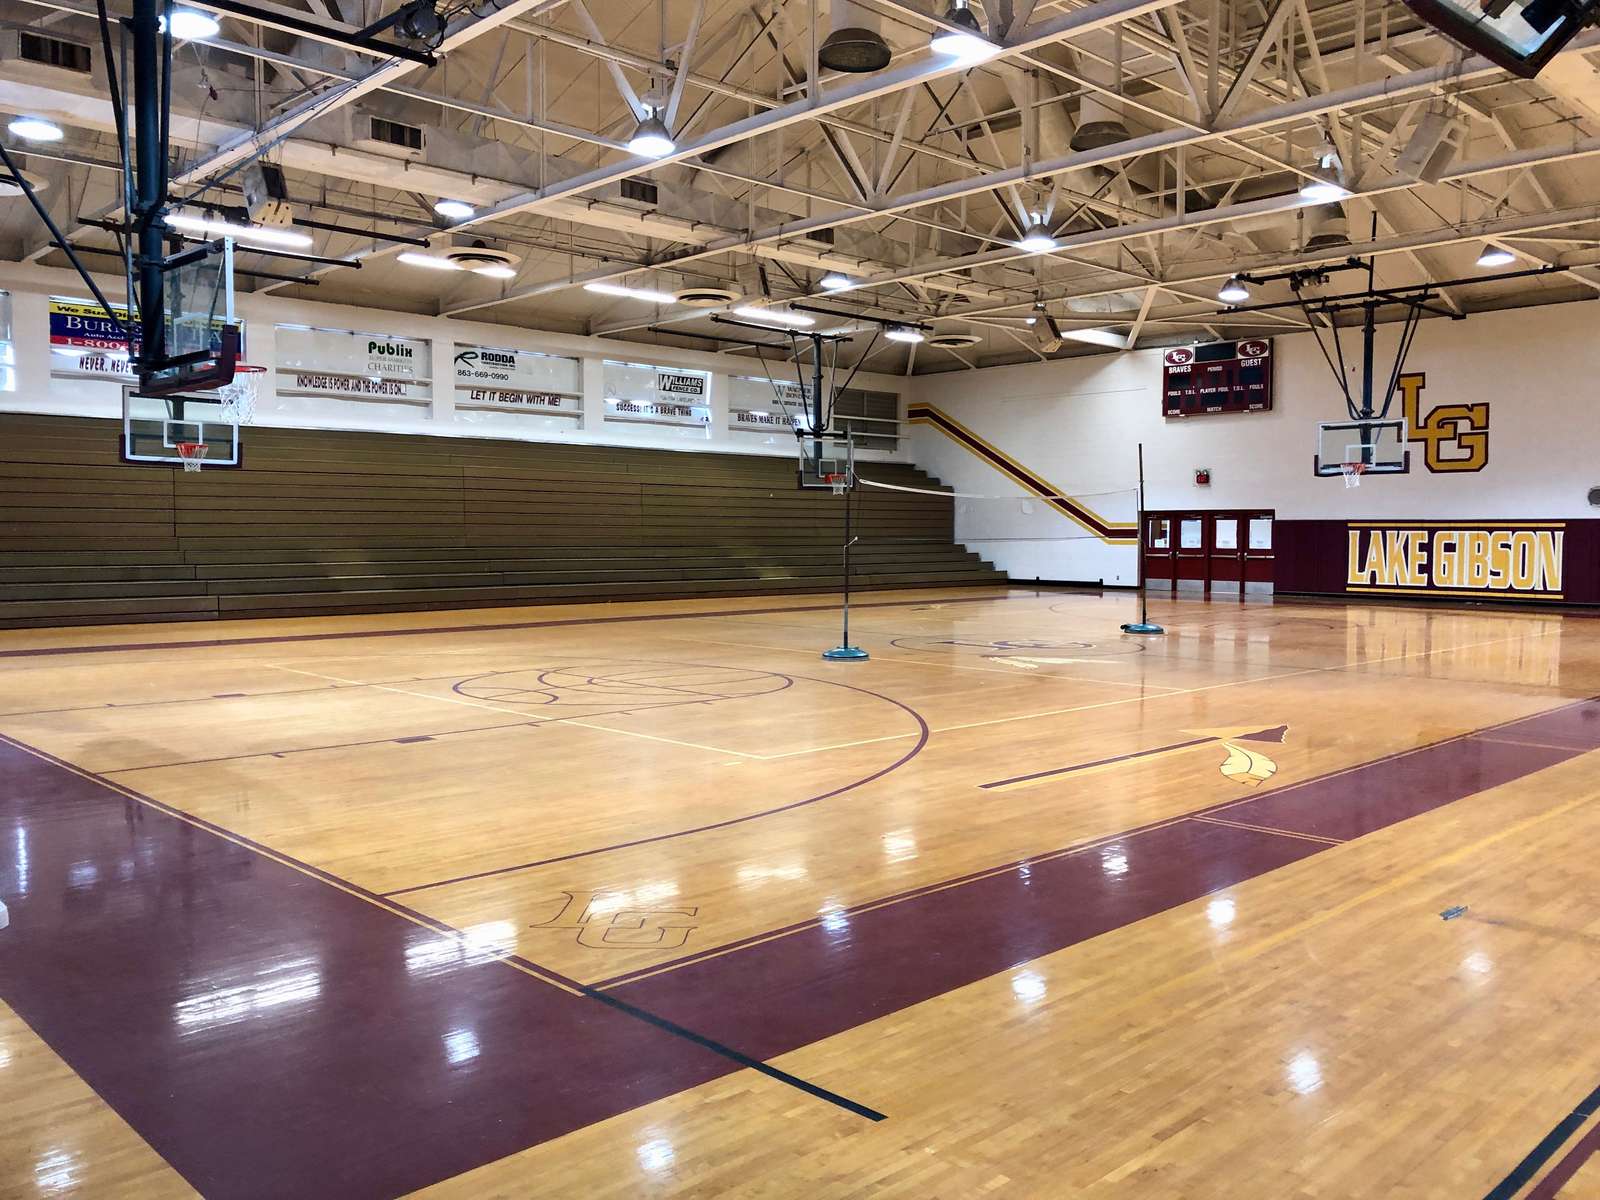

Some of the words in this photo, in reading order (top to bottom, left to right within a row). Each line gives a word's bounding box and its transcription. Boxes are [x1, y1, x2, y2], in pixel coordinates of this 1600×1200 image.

[57, 305, 79, 313] We
[368, 341, 413, 358] Publix
[481, 352, 515, 364] RODDA
[1241, 359, 1262, 367] GUEST
[1168, 365, 1192, 374] BRAVES
[297, 374, 328, 389] KNOWLEDGE
[328, 377, 333, 389] IS
[351, 379, 361, 392] AND
[362, 380, 371, 393] THE
[371, 381, 388, 394] POWER
[659, 375, 703, 391] WILLIAMS
[470, 390, 485, 401] LET
[488, 391, 496, 401] IT
[498, 392, 523, 403] BEGIN
[526, 394, 545, 405] WITH
[660, 406, 676, 416] BRAVE
[677, 407, 692, 417] THING
[737, 413, 757, 424] BRAVES
[758, 415, 774, 424] MAKE
[775, 415, 781, 425] IT
[1397, 371, 1490, 473] LG
[1347, 530, 1429, 587] LAKE
[1432, 530, 1564, 591] GIBSON
